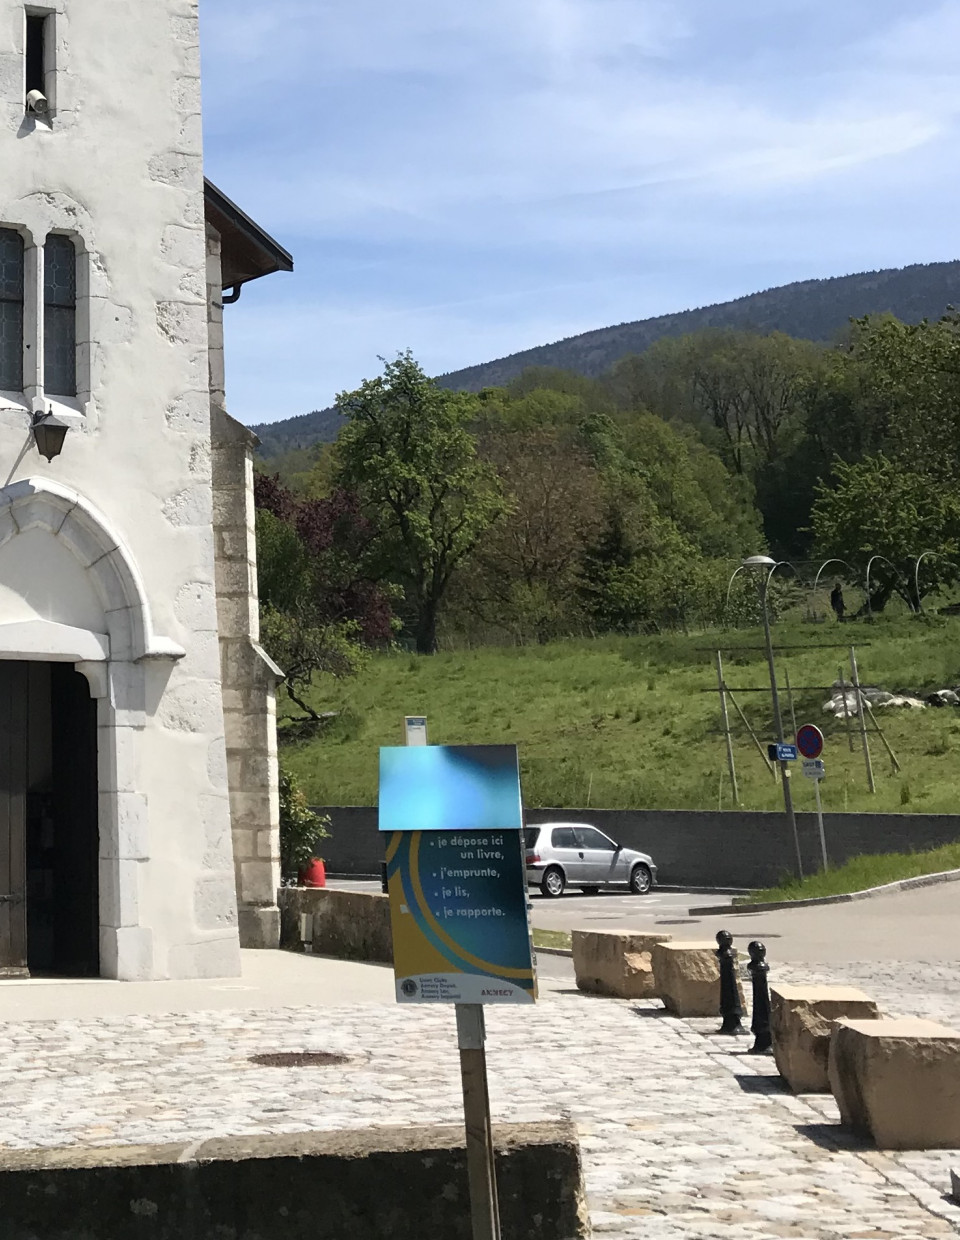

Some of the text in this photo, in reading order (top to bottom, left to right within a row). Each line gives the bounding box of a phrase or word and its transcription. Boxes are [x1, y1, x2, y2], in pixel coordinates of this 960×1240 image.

[438, 835, 503, 848] je dépose ici
[460, 848, 504, 860] un livre,
[440, 867, 500, 879] j'emprunte,
[442, 886, 470, 899] je lis,
[443, 906, 506, 919] je rapporte.
